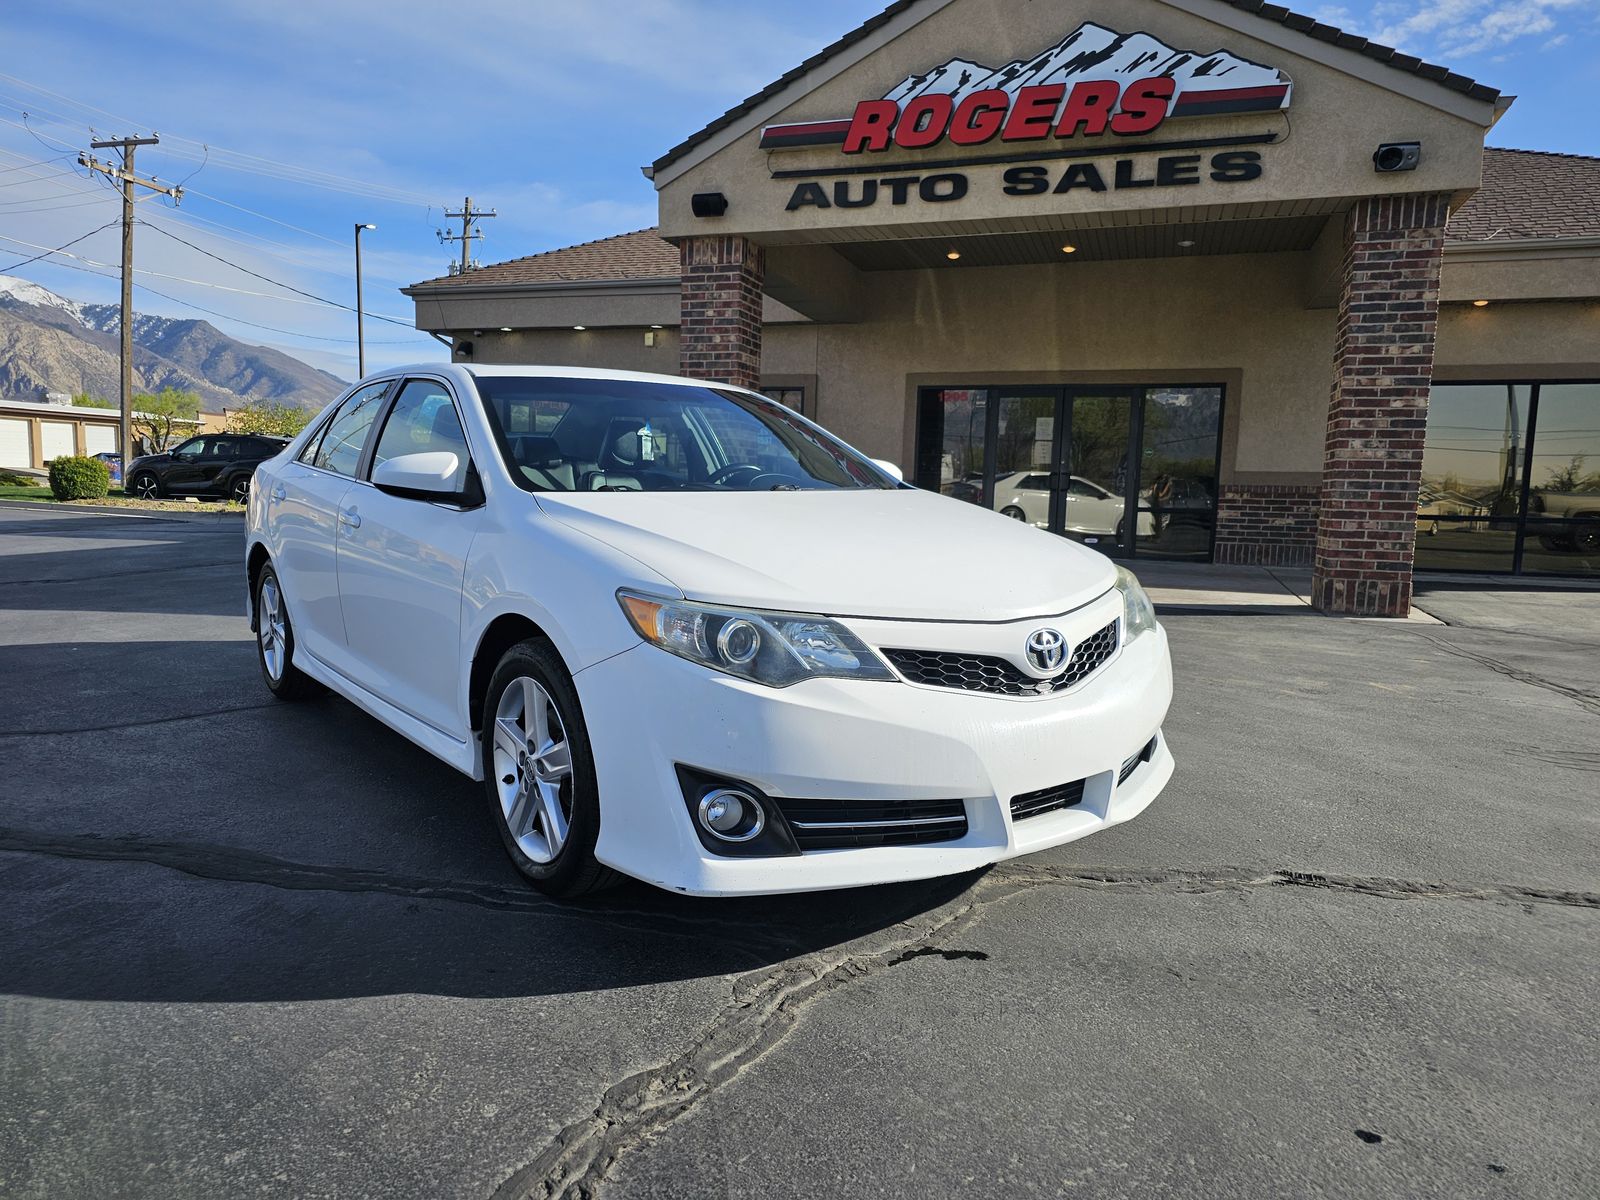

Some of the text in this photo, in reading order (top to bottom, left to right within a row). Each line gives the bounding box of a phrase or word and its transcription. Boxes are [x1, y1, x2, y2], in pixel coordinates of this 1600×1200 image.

[842, 77, 1176, 154] ROGERS
[785, 151, 1262, 211] AUTO SALES
